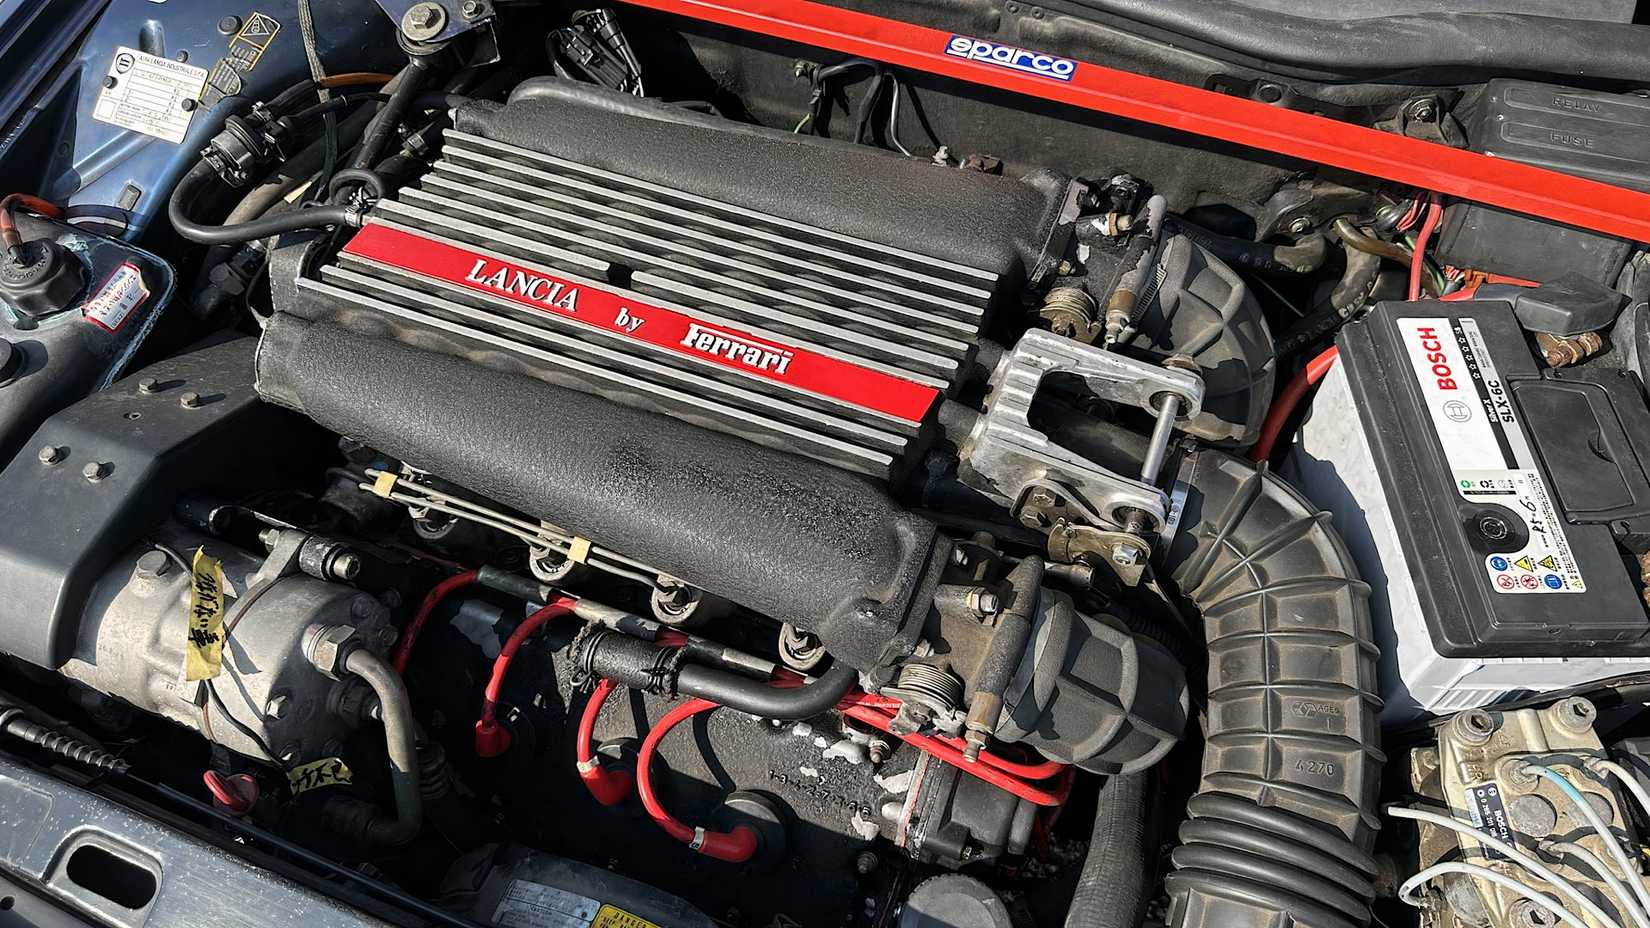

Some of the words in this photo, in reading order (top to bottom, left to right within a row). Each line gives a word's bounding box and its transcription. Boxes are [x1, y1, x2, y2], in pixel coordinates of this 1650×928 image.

[948, 37, 1074, 79] sparco
[1552, 97, 1600, 113] RELAY
[1550, 133, 1593, 148] FUSE
[465, 259, 579, 312] LANCIA
[614, 308, 645, 333] by
[680, 322, 795, 375] Ferrari
[1417, 327, 1458, 390] BOSCH
[1488, 380, 1515, 423] SLX-6C
[1295, 759, 1335, 776] 4270
[1494, 809, 1509, 839] BOSCH
